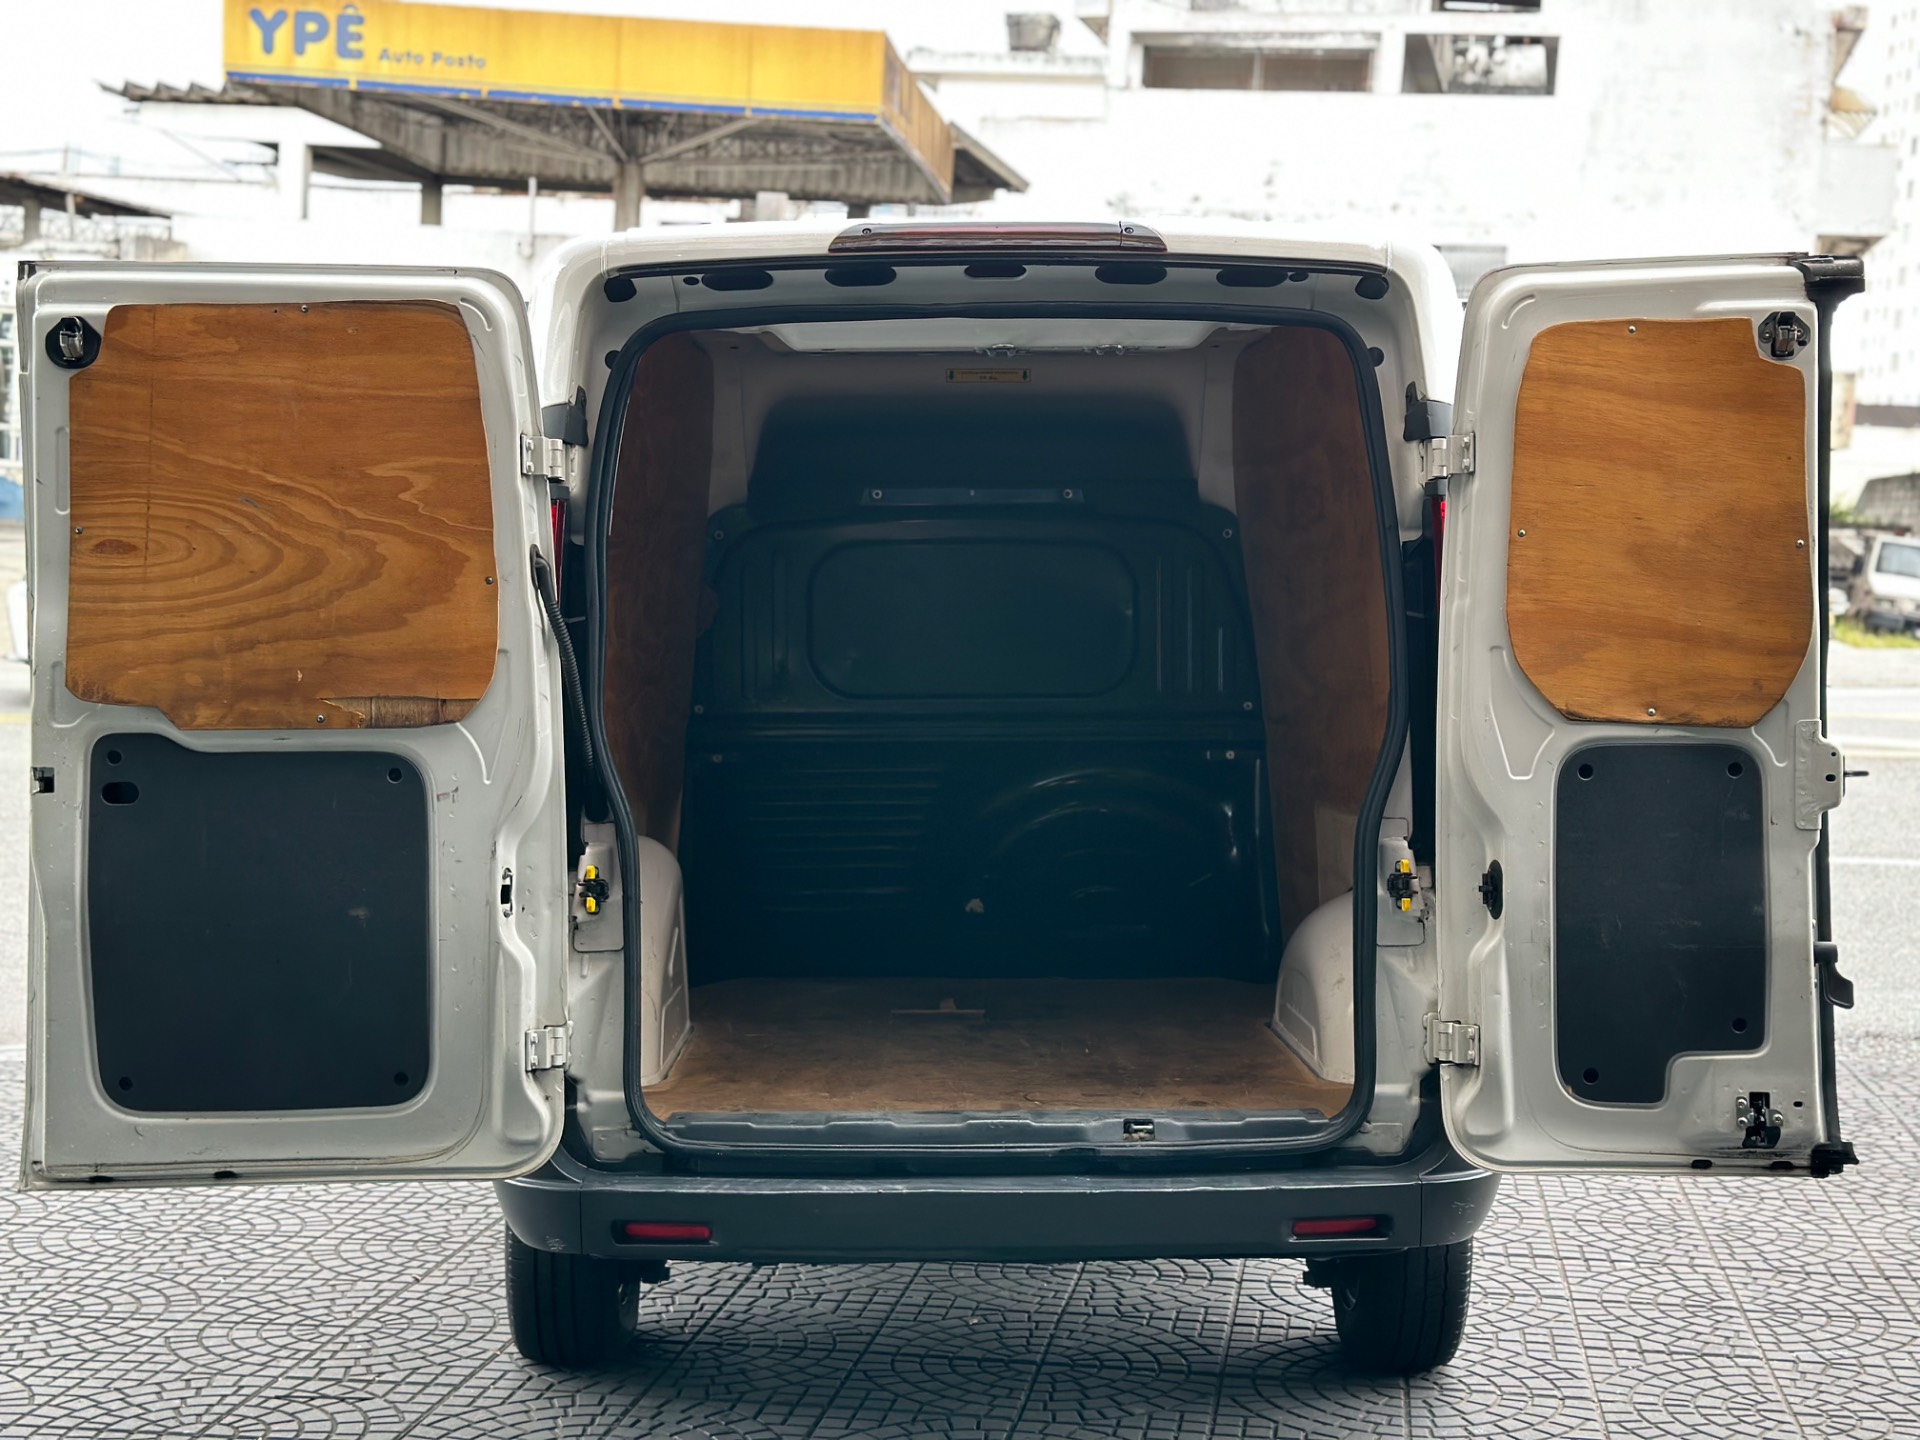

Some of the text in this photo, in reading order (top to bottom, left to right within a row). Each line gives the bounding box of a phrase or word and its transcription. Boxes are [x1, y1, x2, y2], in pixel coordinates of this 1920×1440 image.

[249, 3, 365, 59] YPÊ
[378, 47, 487, 69] Auto Posto
